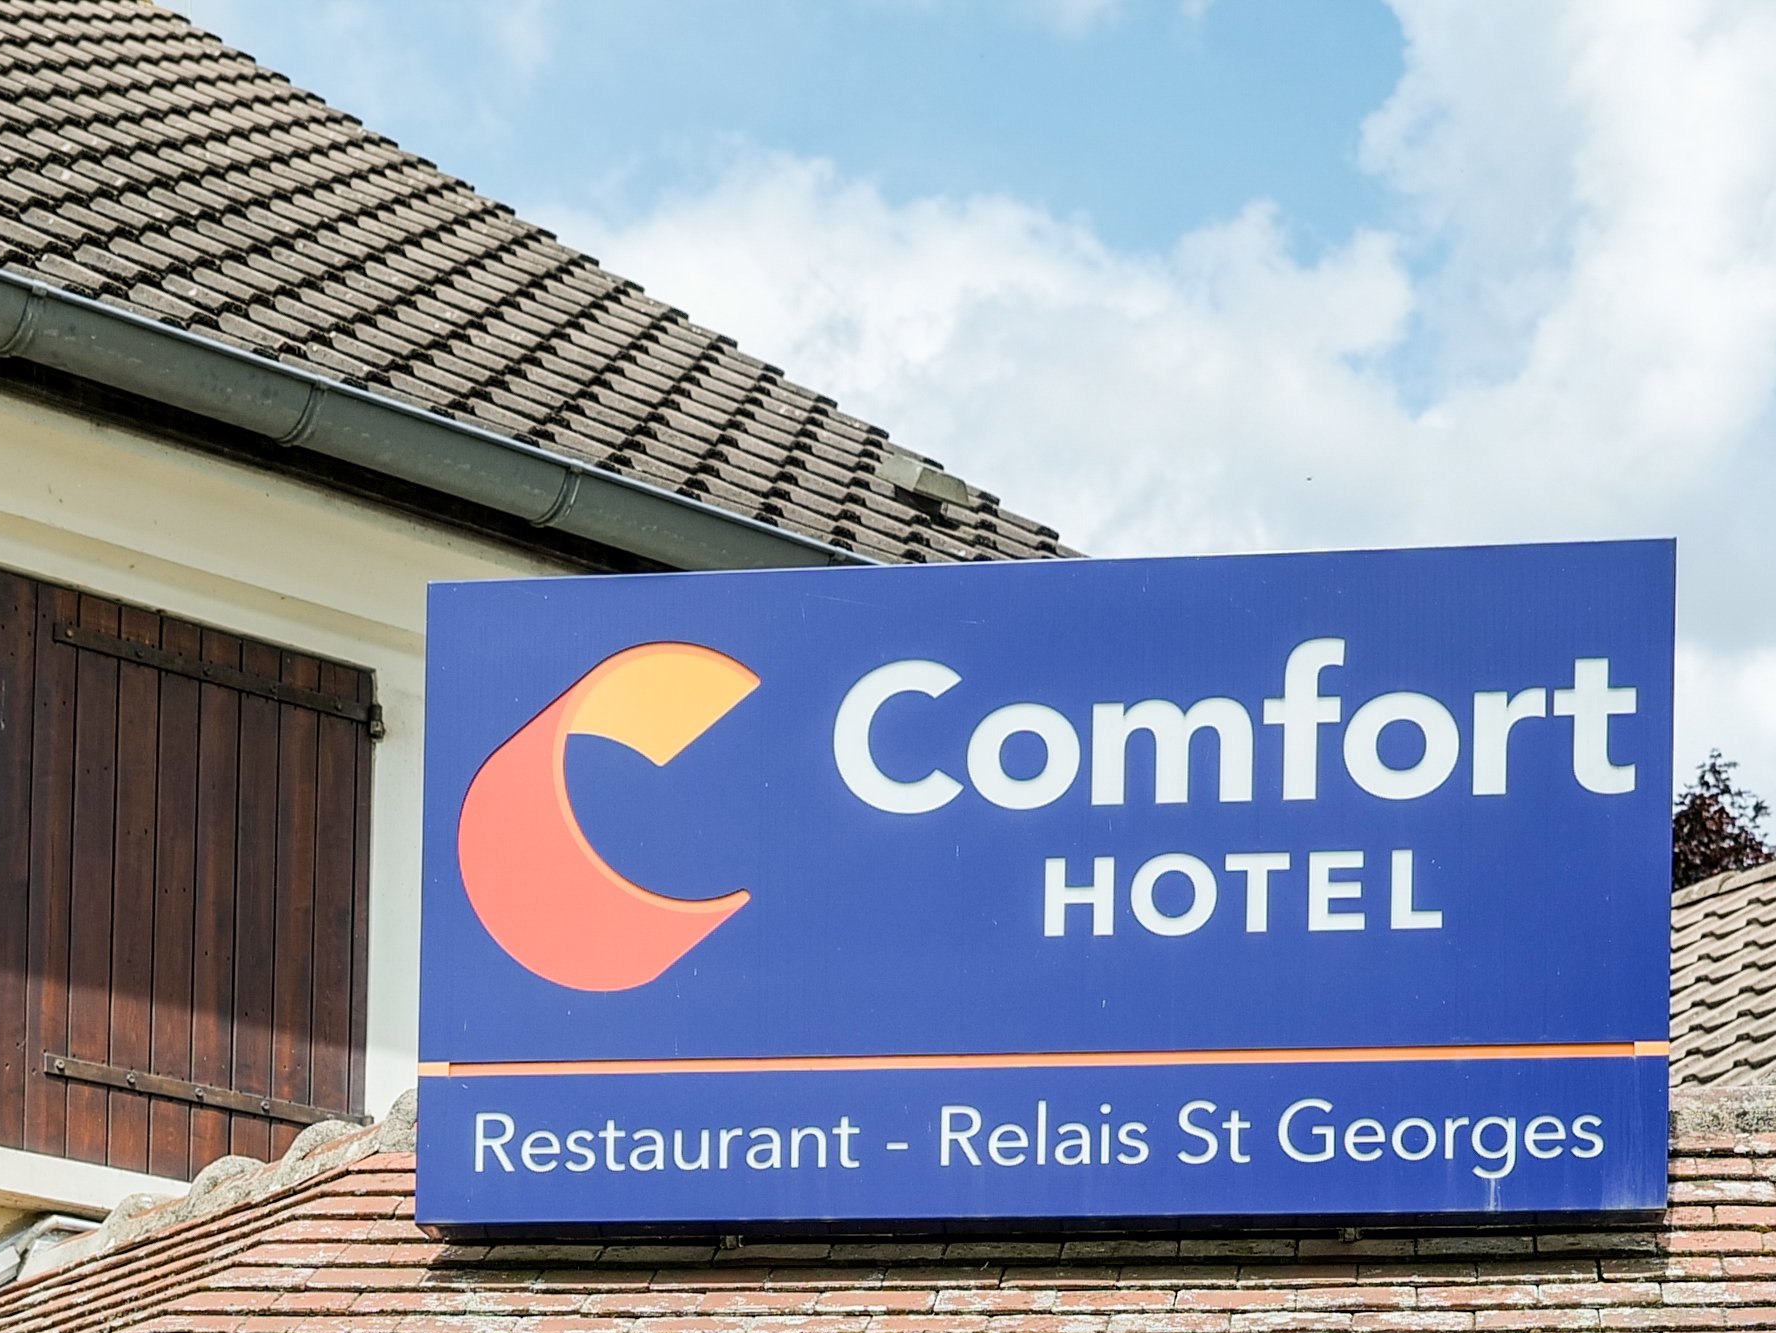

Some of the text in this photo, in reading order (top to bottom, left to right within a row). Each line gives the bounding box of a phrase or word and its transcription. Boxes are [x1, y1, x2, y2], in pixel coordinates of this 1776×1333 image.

[833, 637, 1638, 815] Comfort
[1042, 849, 1443, 938] HOTEL
[472, 1109, 860, 1176] Restaurant
[938, 1099, 1150, 1170] Relais
[1177, 1099, 1252, 1168] St
[1277, 1097, 1605, 1180] Georges
